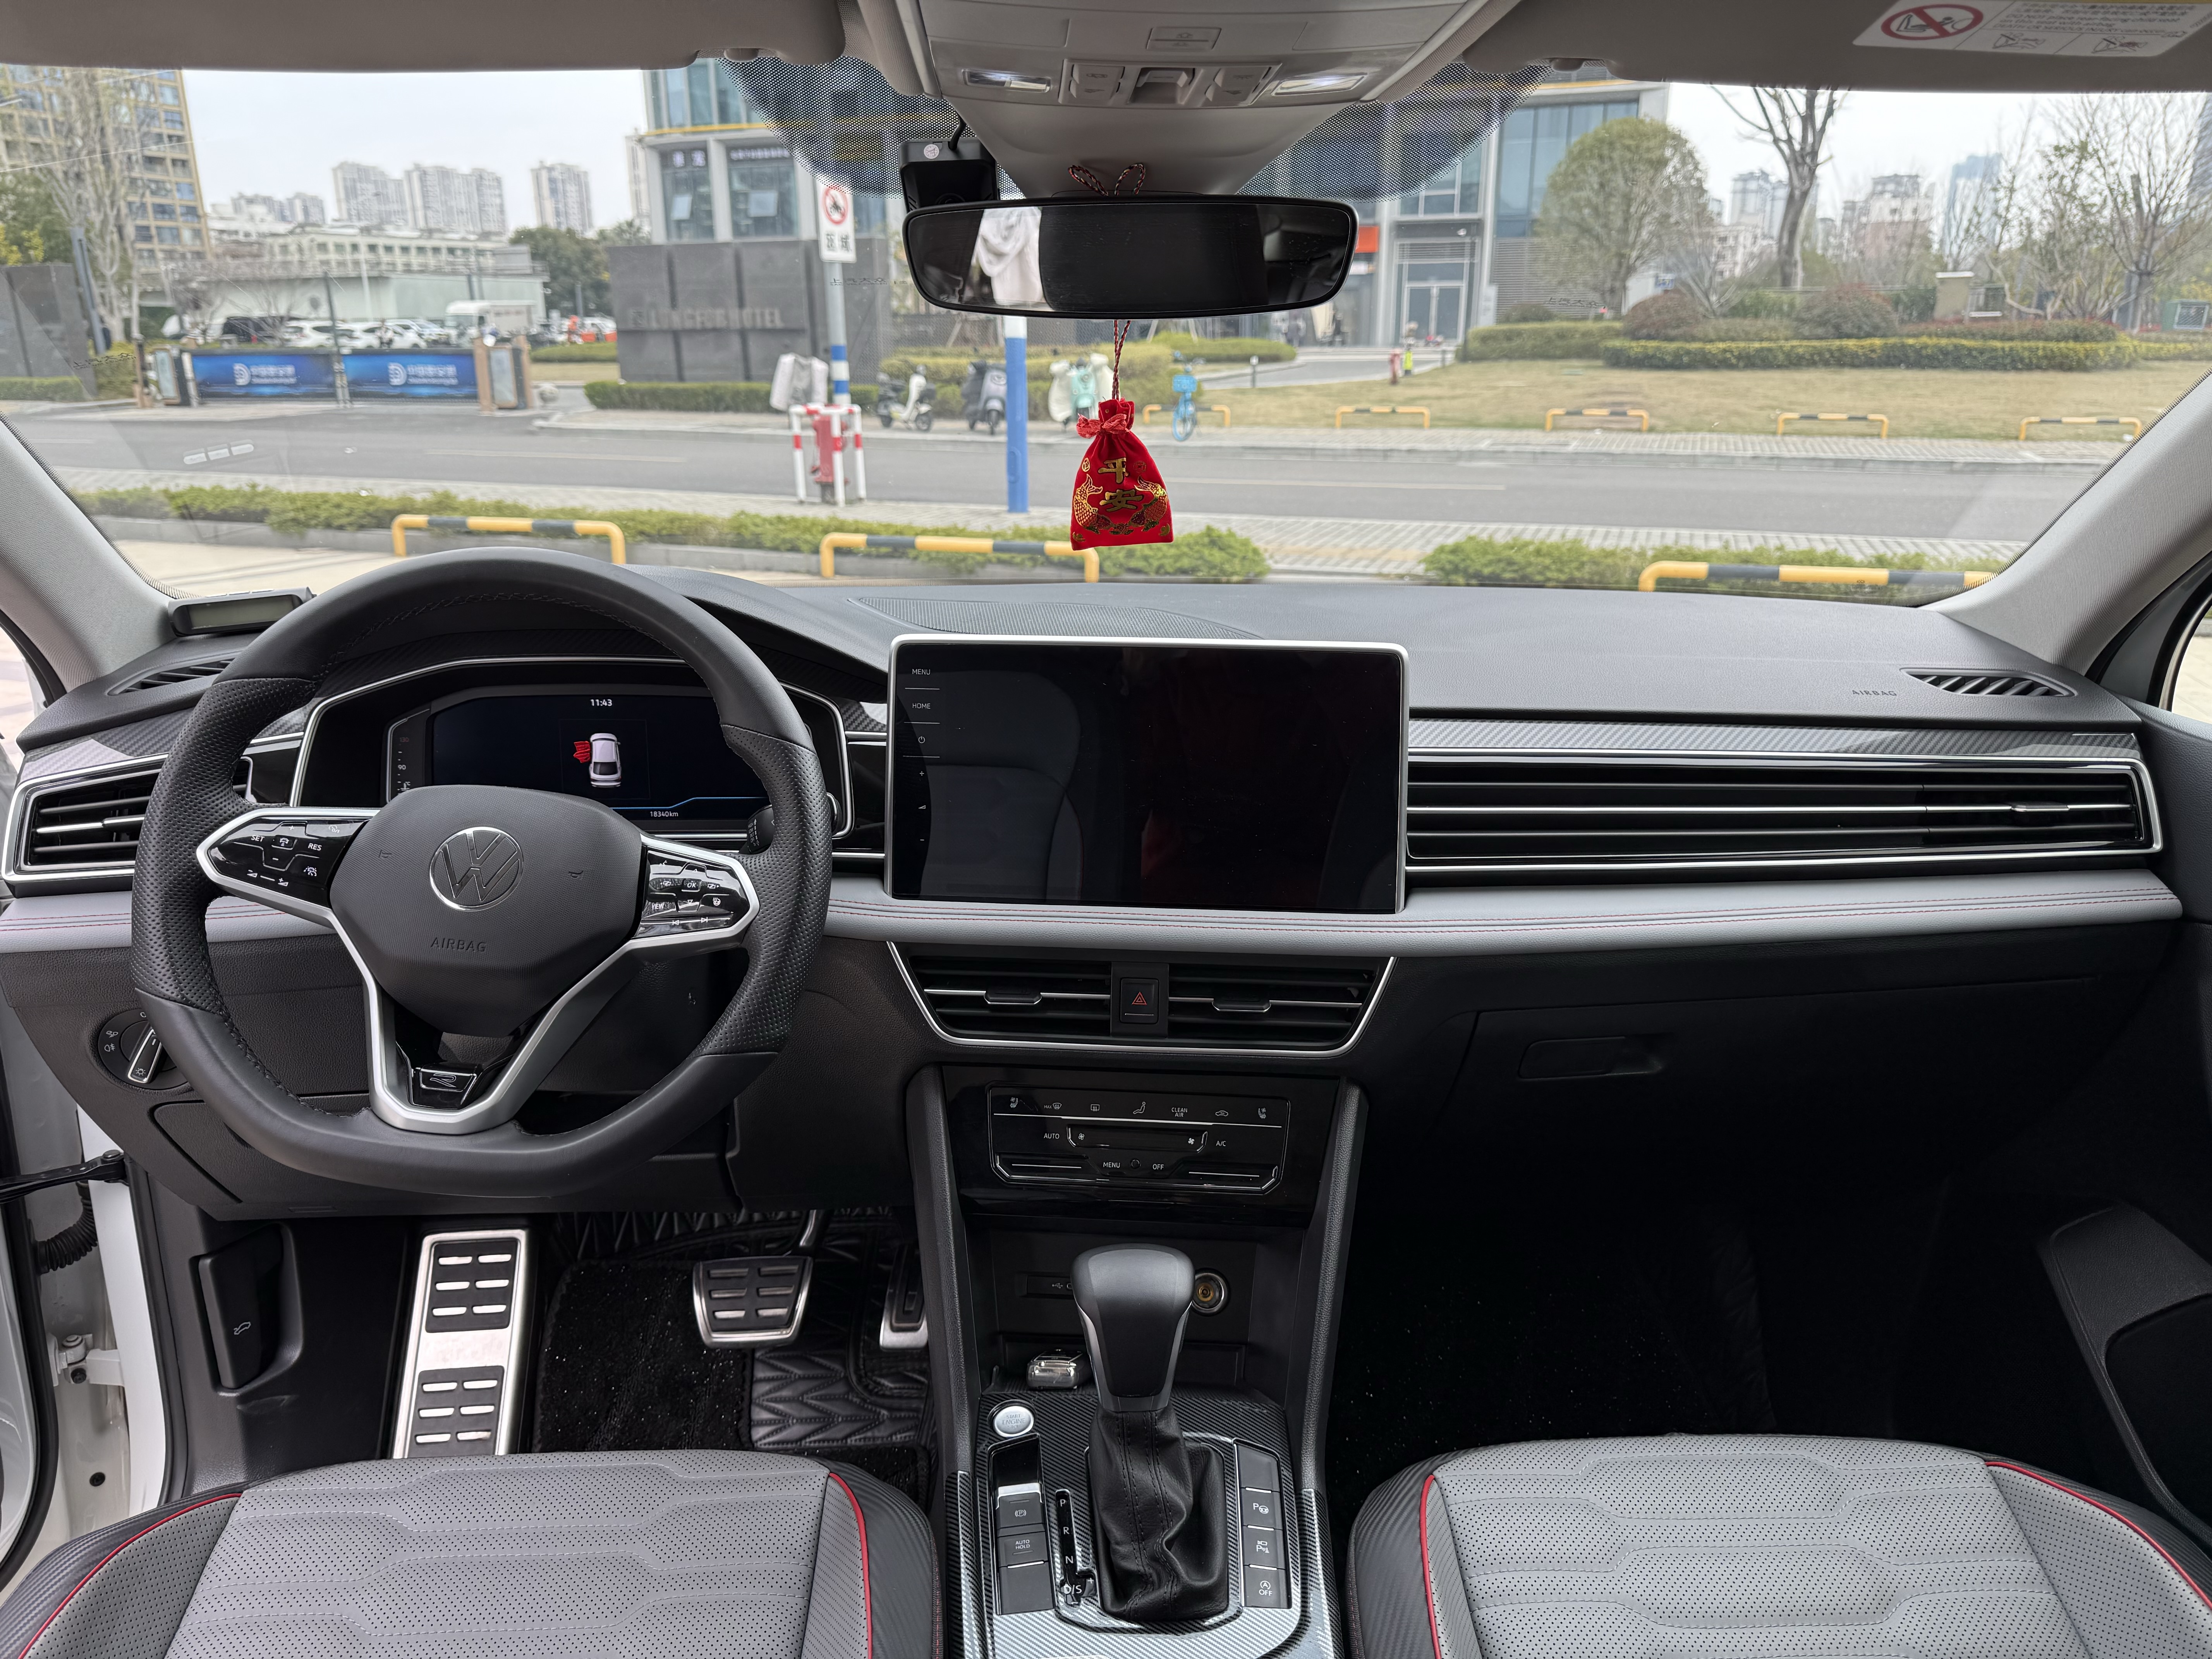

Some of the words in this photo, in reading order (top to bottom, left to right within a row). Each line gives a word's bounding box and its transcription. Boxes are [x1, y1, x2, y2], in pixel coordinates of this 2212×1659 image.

[1098, 457, 1144, 512] 平安
[308, 843, 322, 851] RES
[430, 937, 488, 952] AIRBAG
[1064, 1584, 1082, 1594] D/S
